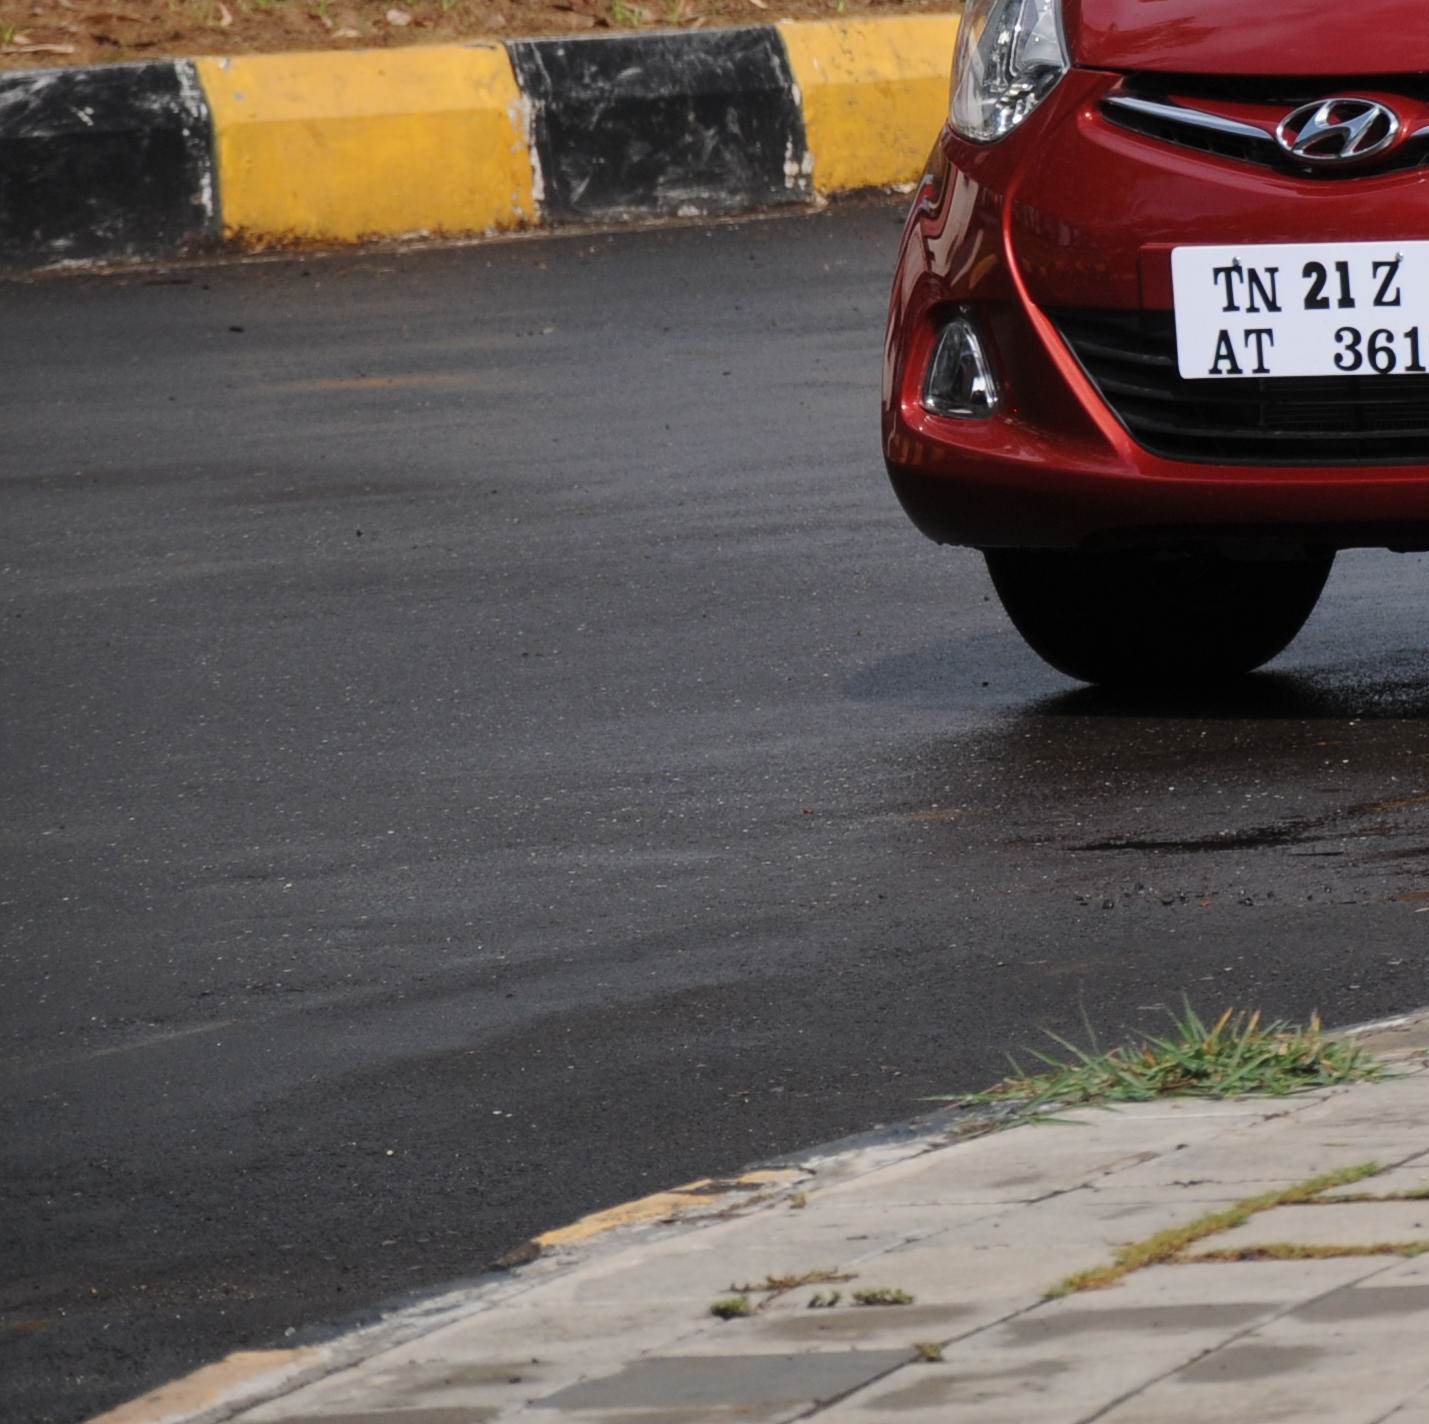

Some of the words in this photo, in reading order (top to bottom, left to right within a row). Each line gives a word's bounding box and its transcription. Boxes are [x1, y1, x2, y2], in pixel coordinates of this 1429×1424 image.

[1212, 265, 1283, 314] TN
[1301, 261, 1357, 310] 21
[1372, 260, 1402, 308] Z
[1208, 328, 1275, 375] AT
